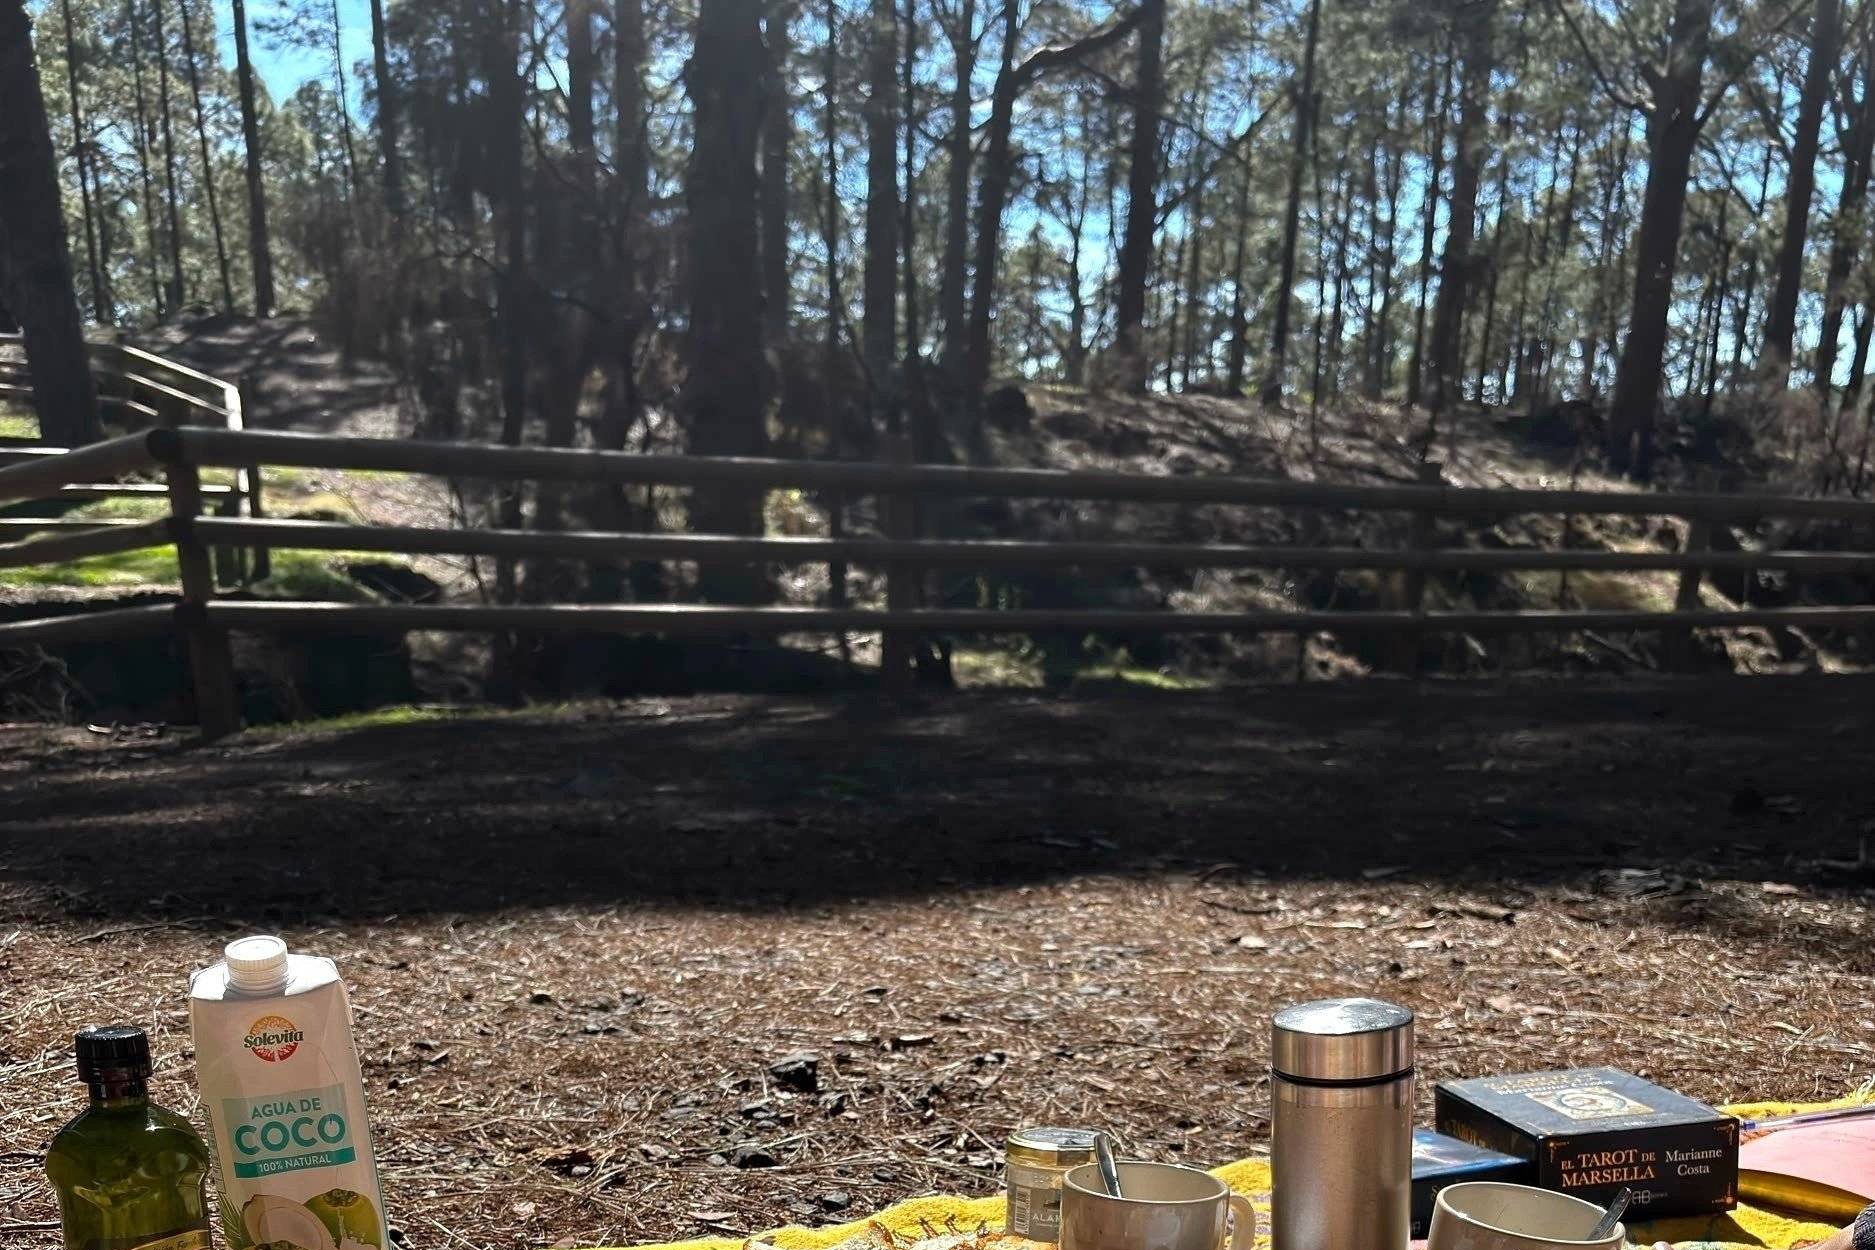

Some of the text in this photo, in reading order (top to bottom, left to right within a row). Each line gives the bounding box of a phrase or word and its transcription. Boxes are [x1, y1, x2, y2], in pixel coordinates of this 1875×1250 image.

[243, 1029, 304, 1049] Solevita
[251, 1097, 322, 1120] AGUA DE
[234, 1113, 346, 1156] COCO
[258, 1154, 332, 1173] 100% NATURAL
[1561, 1149, 1656, 1171] EL TAROT DE
[1665, 1147, 1723, 1163] Marianne
[1561, 1166, 1655, 1188] MARSELLA
[1677, 1163, 1710, 1177] Costa
